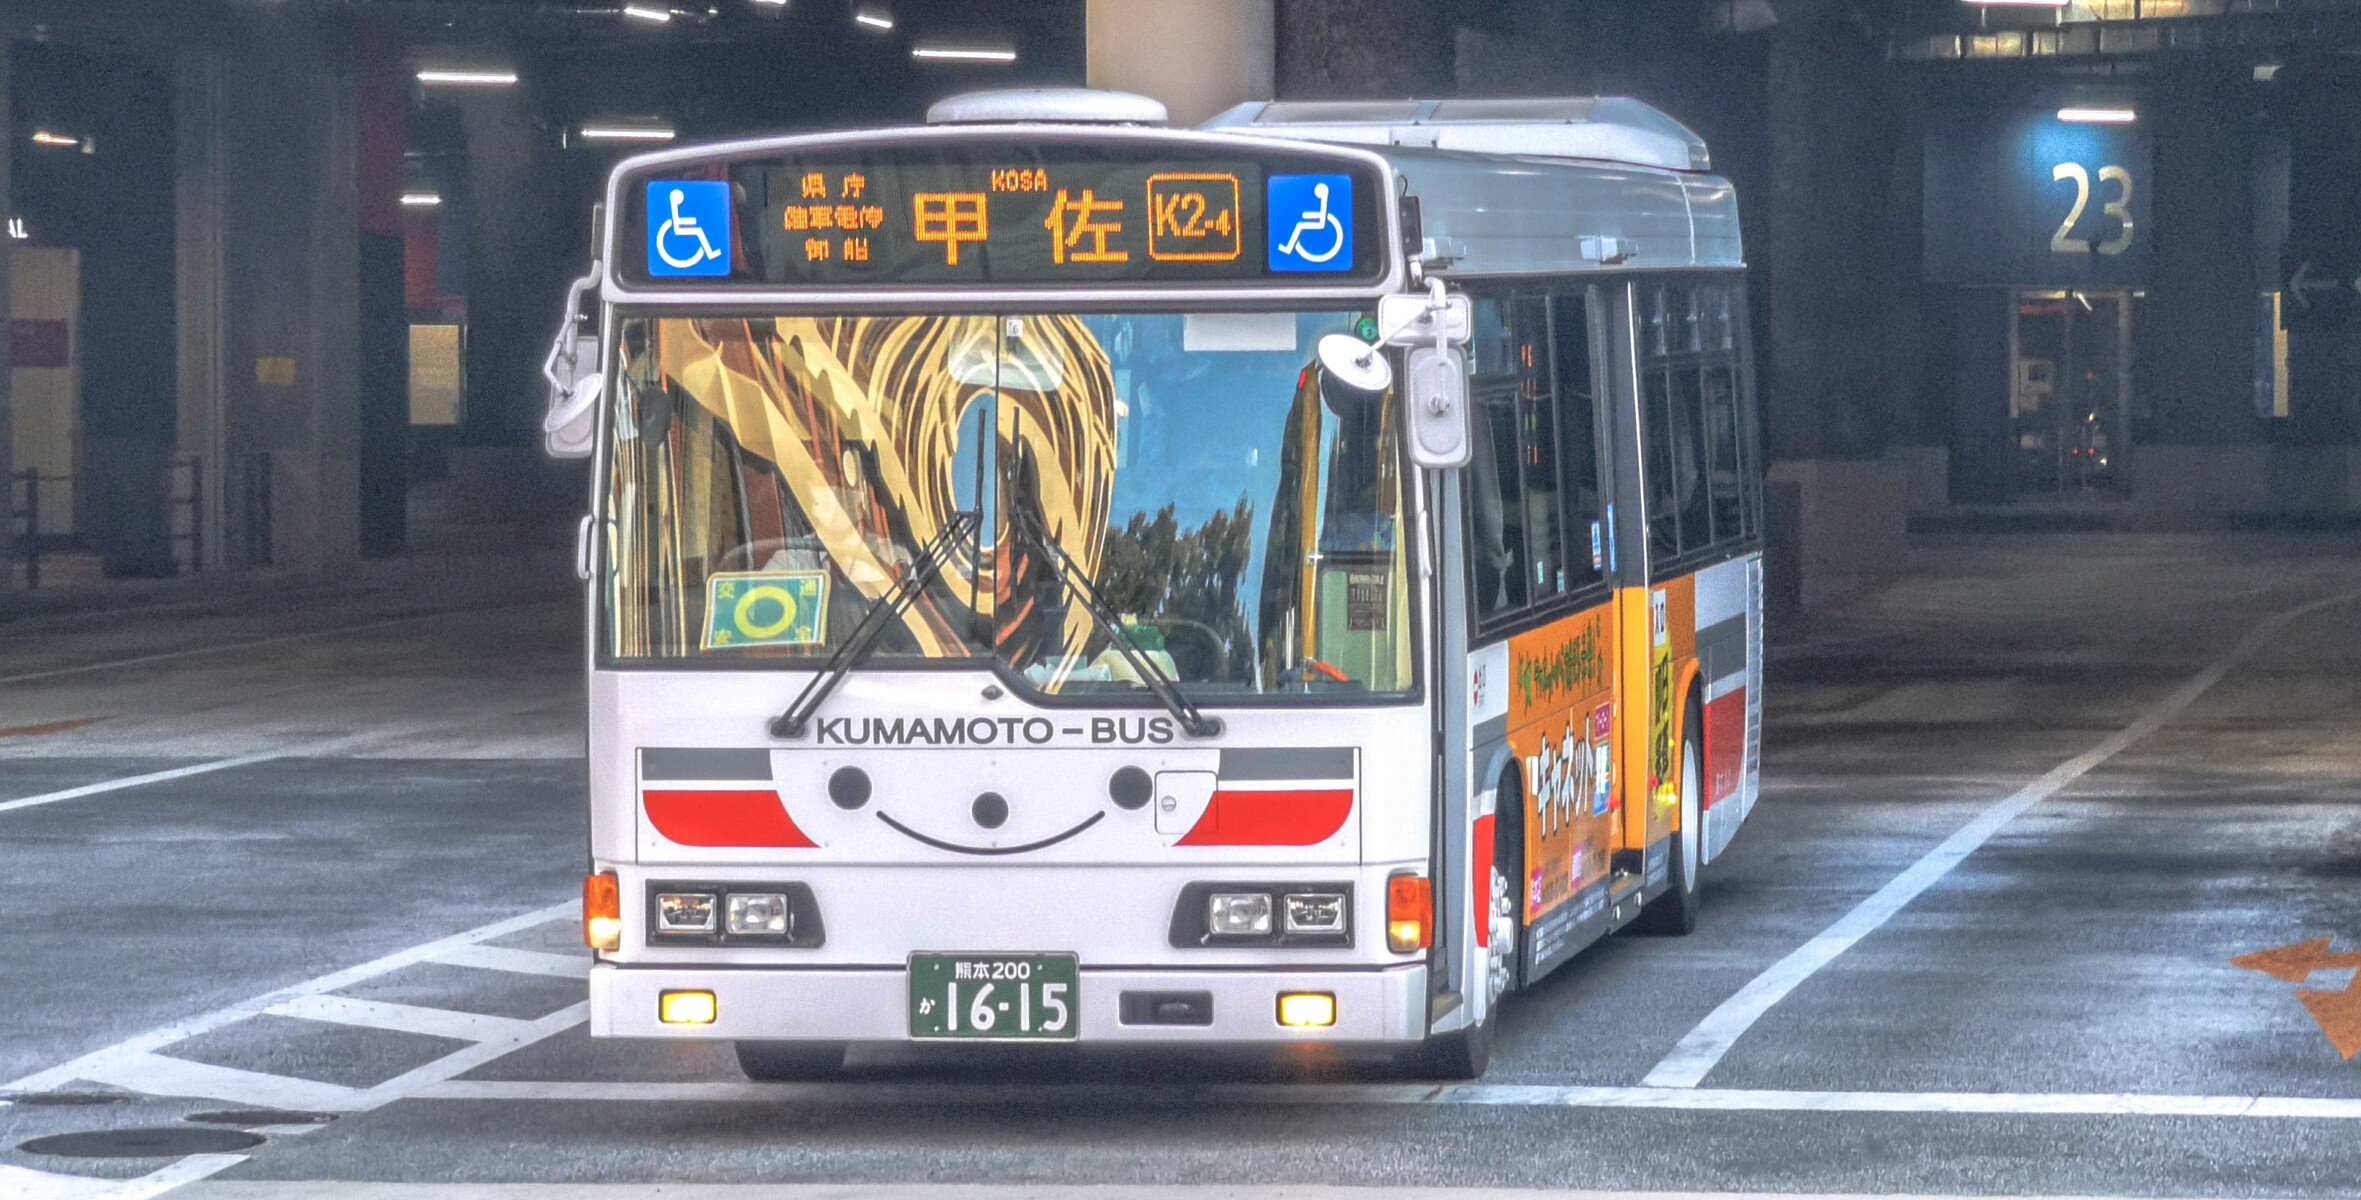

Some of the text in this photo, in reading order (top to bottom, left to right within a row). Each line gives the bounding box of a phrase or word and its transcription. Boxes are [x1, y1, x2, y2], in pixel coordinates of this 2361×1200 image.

[991, 168, 1048, 192] KOSA
[914, 188, 1128, 266] 甲佐
[2050, 162, 2135, 254] 23
[816, 717, 1054, 745] KUMAMOTO
[1090, 717, 1175, 744] BUS
[955, 961, 1031, 980] 熊本200
[919, 982, 1068, 1032] か 16-15
